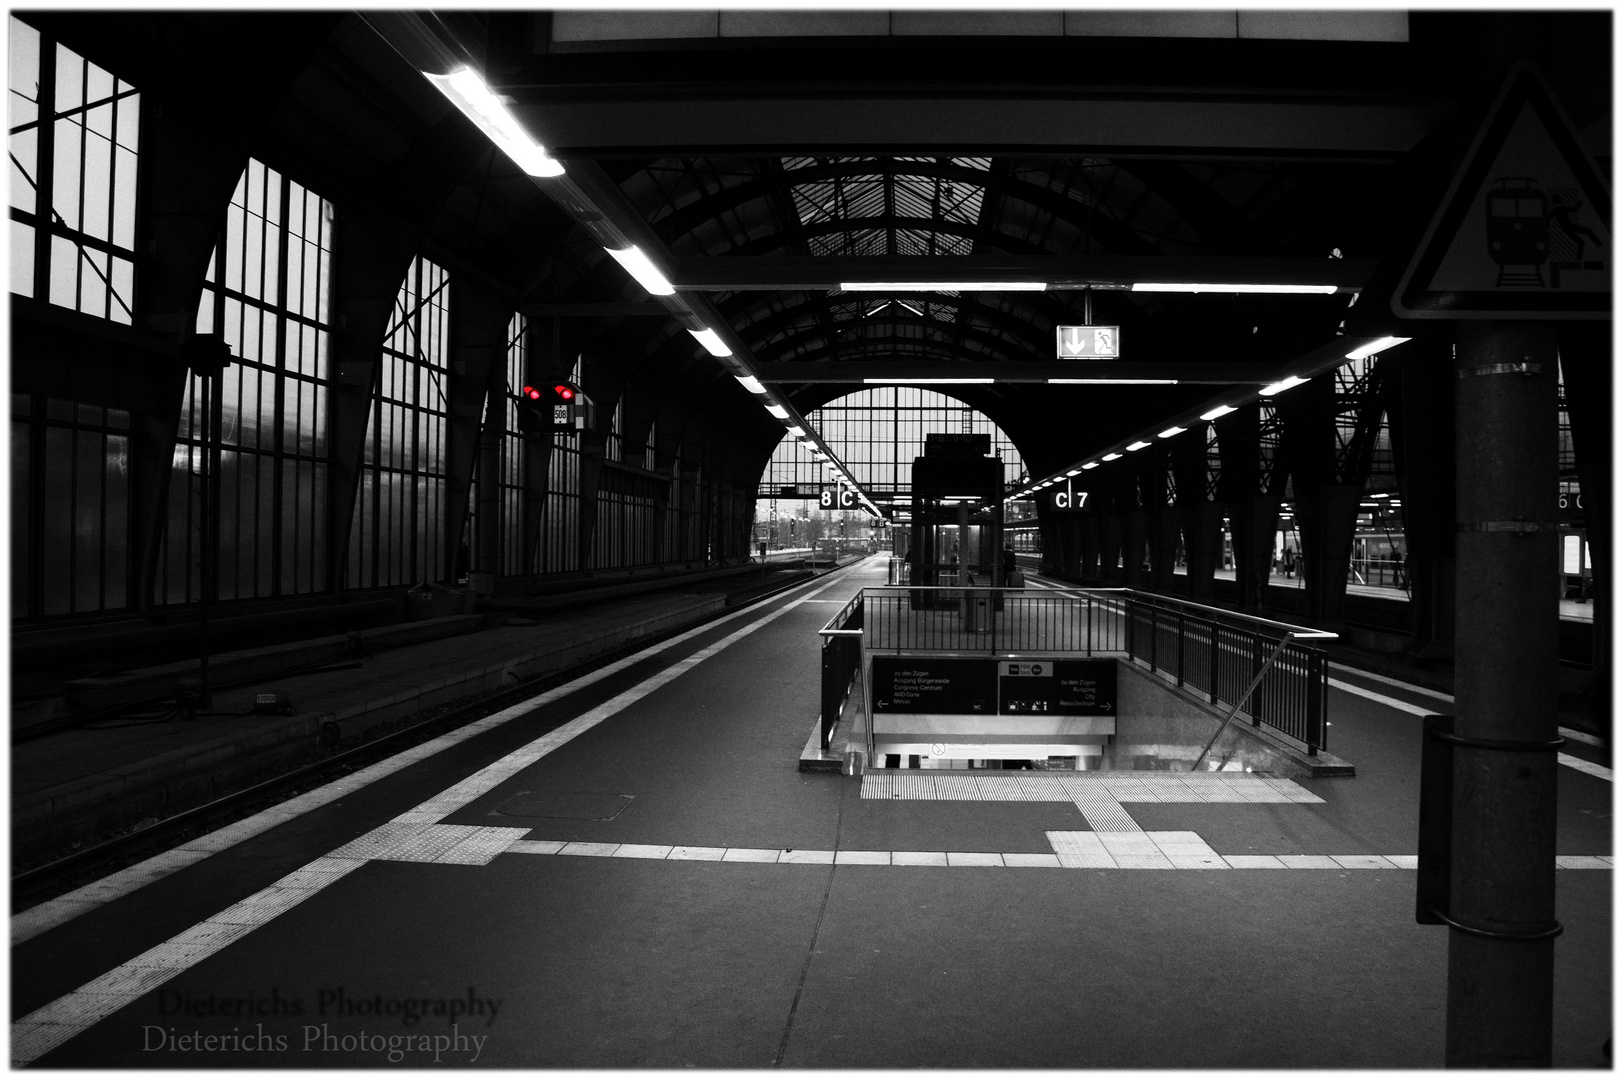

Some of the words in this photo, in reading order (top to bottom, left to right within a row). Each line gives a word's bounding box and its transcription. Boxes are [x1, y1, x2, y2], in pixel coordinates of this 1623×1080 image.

[554, 410, 567, 419] 508
[821, 491, 832, 507] 8
[841, 491, 854, 507] C
[1055, 492, 1068, 508] C
[1077, 492, 1089, 508] 7
[1558, 494, 1568, 509] 6
